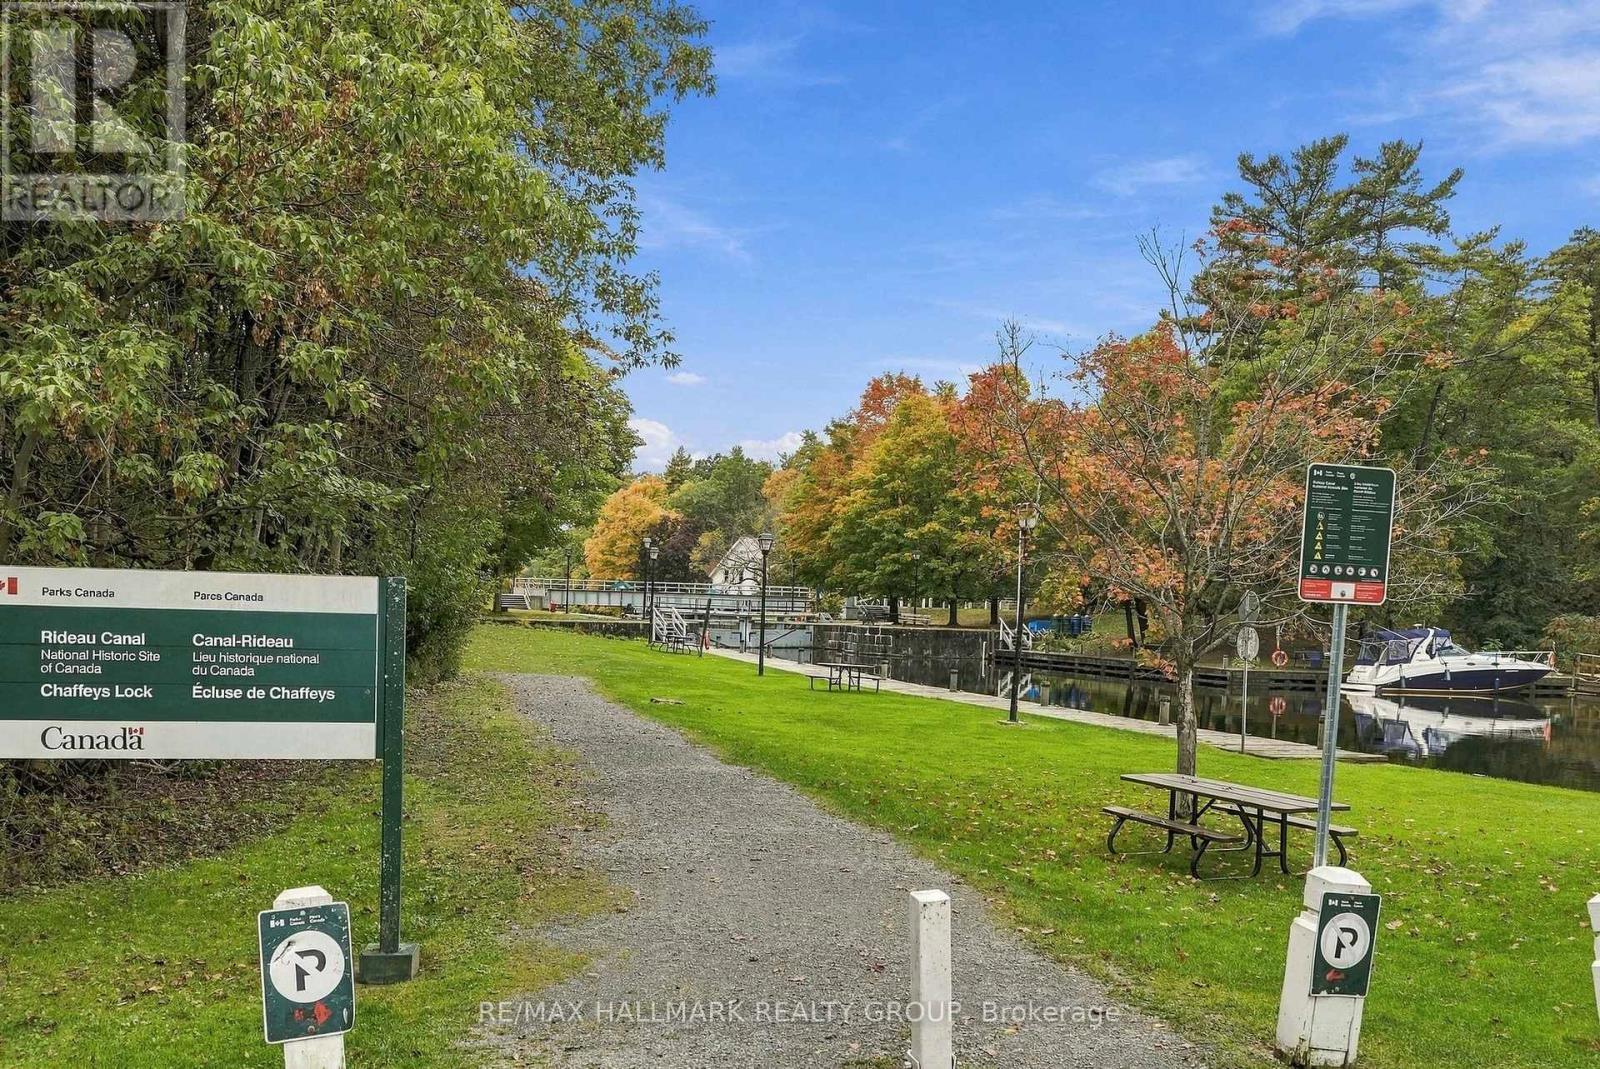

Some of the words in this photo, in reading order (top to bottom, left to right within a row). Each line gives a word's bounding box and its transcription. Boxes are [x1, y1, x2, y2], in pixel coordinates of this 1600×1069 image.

[42, 587, 72, 597] Parks
[75, 587, 115, 598] Canada
[193, 591, 222, 601] Parcs
[225, 592, 264, 602] Canada
[41, 630, 96, 645] Rideau
[100, 631, 146, 645] Canal
[192, 633, 293, 648] Canal-Rideau
[41, 649, 89, 661] National
[92, 650, 136, 661] Historic
[138, 651, 161, 662] Site
[193, 652, 216, 663] Lieu
[219, 652, 273, 666] historique
[276, 653, 320, 664] national
[41, 662, 53, 674] of
[55, 663, 102, 675] Canada
[192, 665, 207, 676] du
[210, 665, 255, 676] Canada
[40, 683, 111, 700] Chaffeys
[115, 685, 153, 698] Lock
[192, 682, 243, 699] Écluse
[247, 686, 266, 699] de
[269, 686, 336, 703] Chaffeys
[41, 726, 144, 751] Canada
